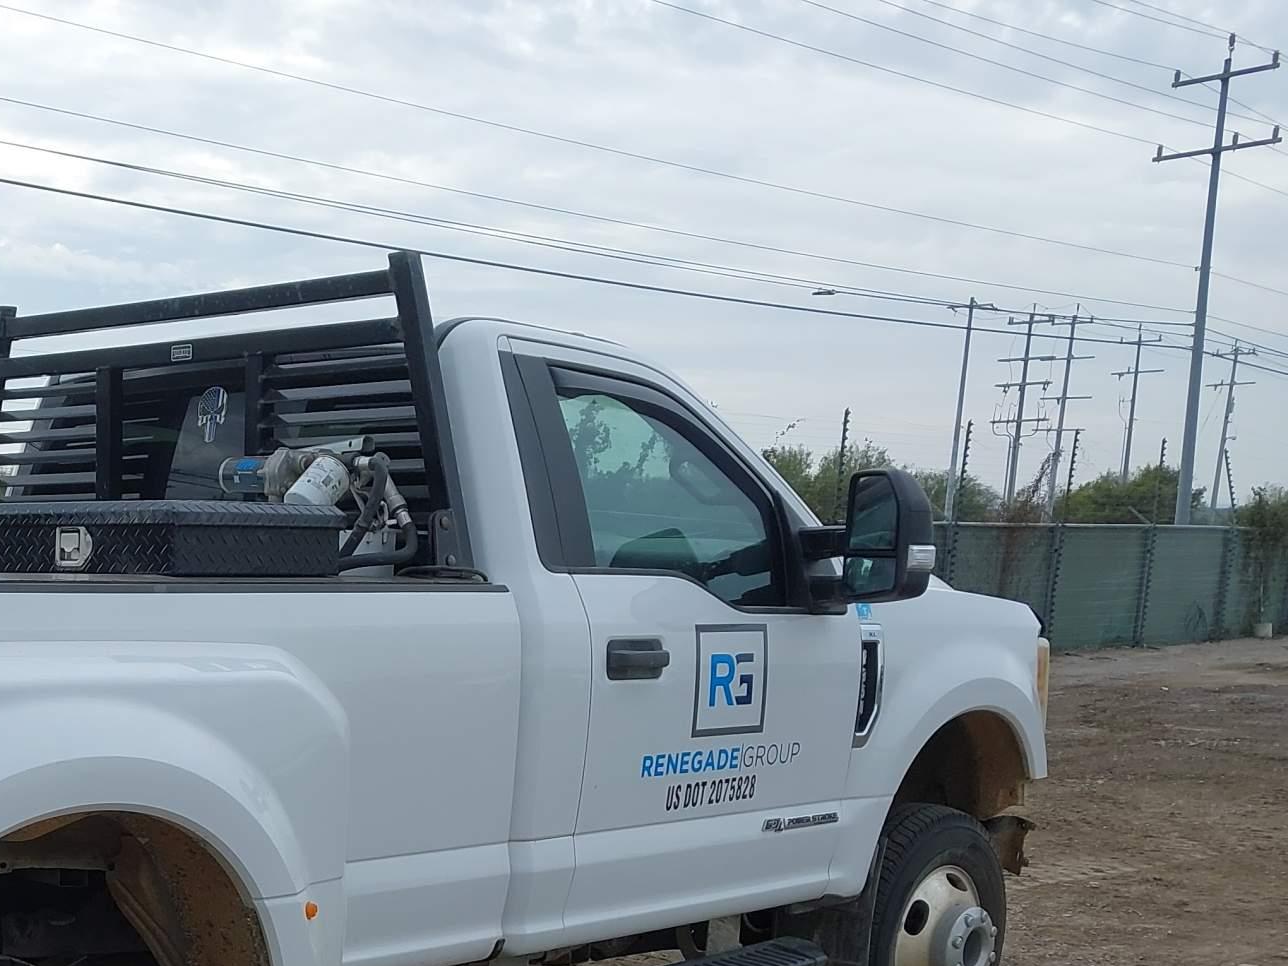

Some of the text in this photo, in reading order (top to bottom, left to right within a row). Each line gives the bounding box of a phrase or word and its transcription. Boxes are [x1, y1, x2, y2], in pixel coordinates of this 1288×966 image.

[708, 652, 754, 708] RG
[640, 742, 801, 778] RENEGADE GROUP
[665, 774, 757, 811] US DOT 2075828
